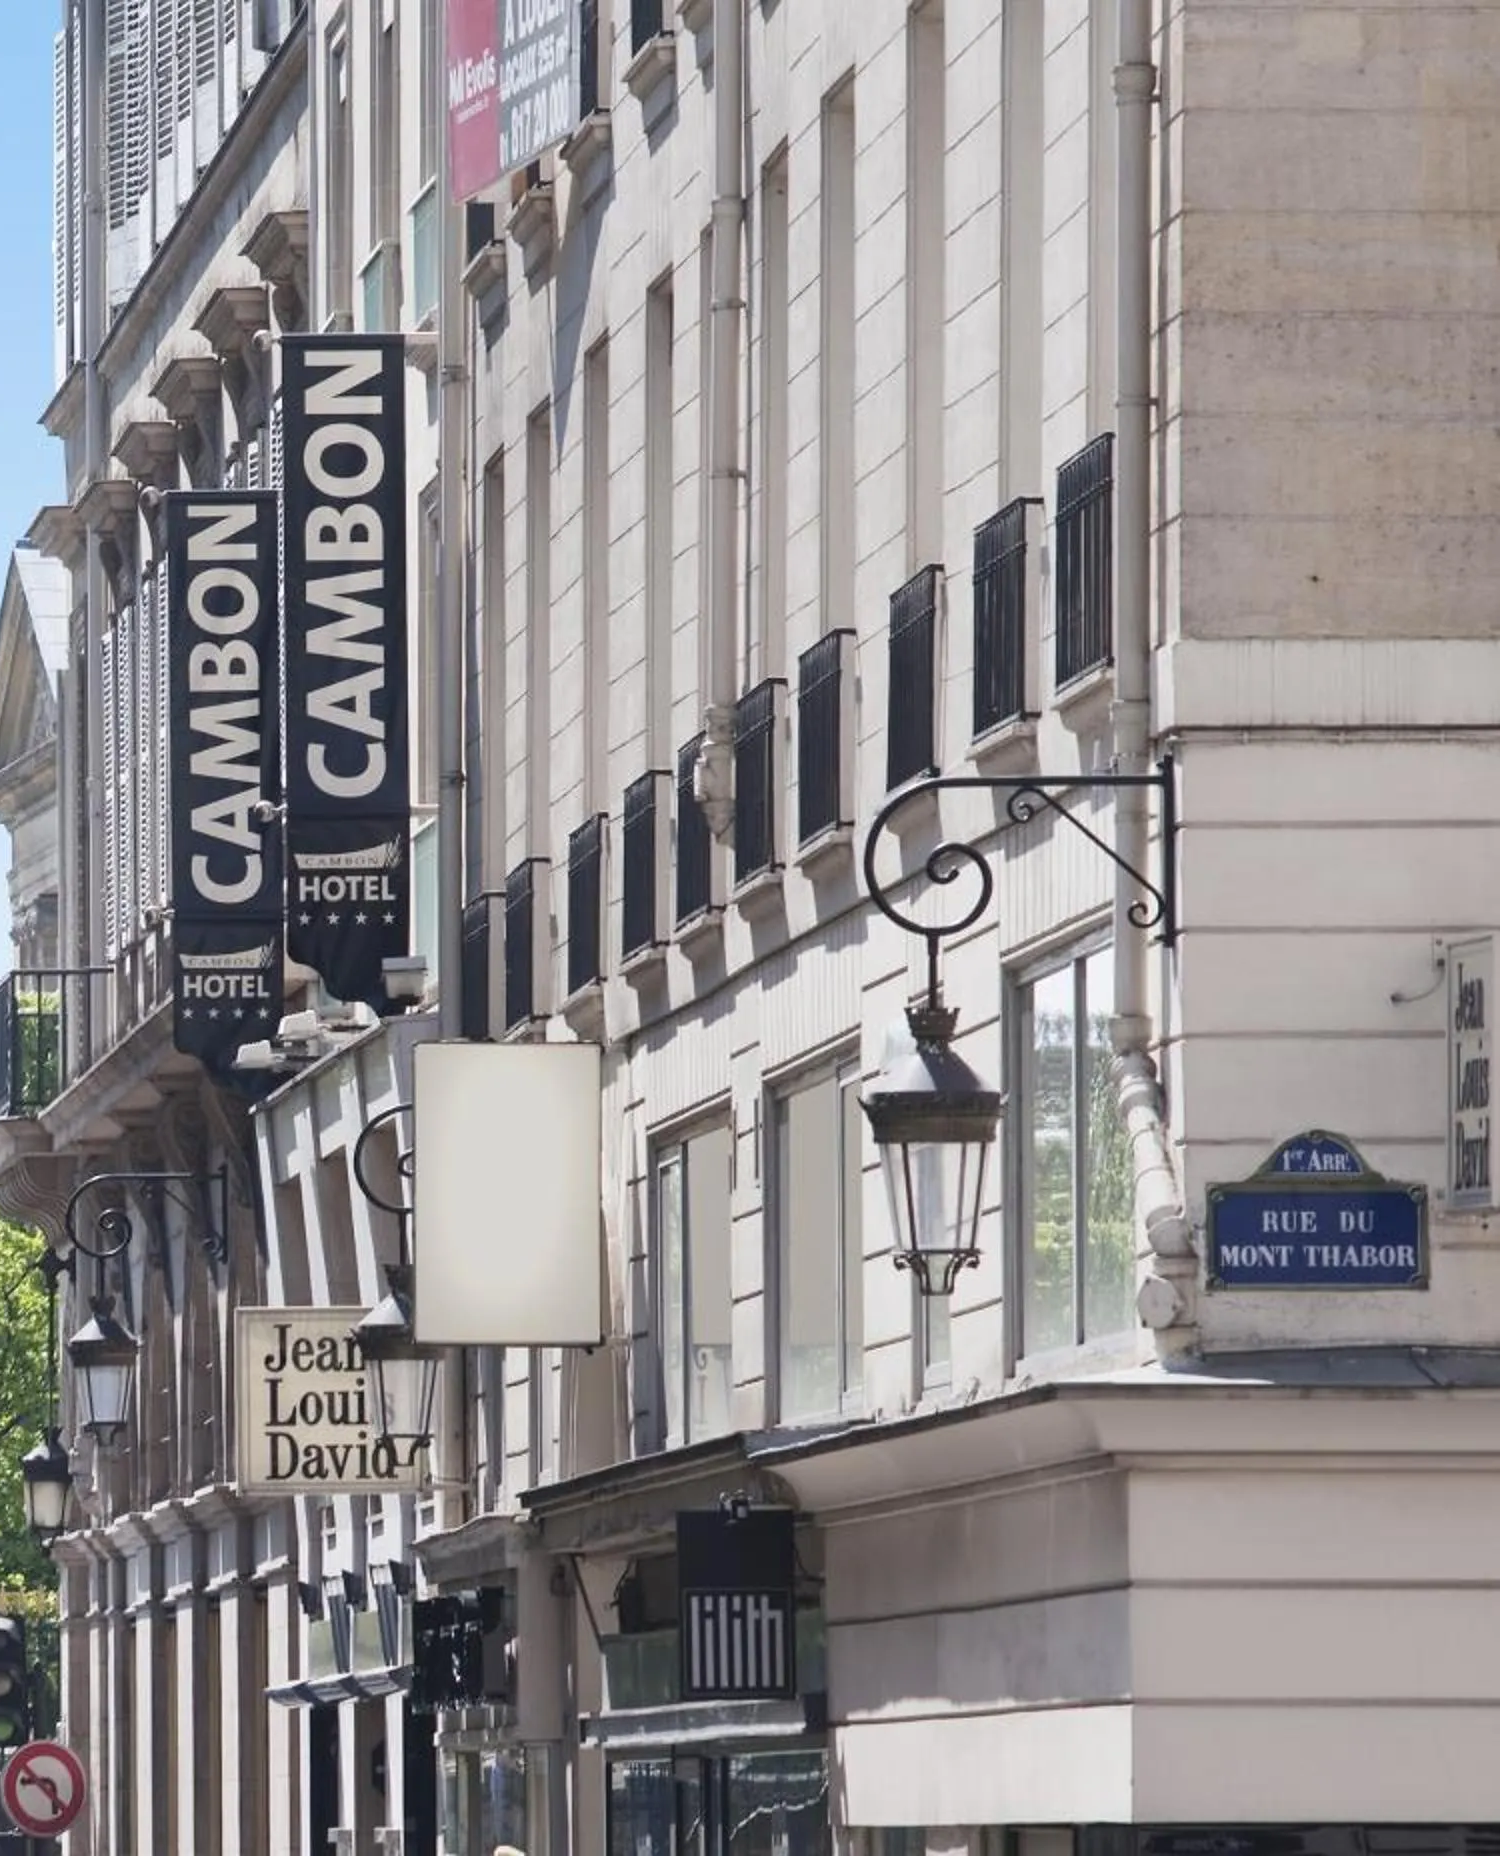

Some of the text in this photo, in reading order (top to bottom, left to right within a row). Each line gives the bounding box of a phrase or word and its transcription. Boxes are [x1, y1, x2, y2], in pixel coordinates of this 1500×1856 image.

[518, 0, 565, 38] LOU
[303, 349, 387, 798] CAMBON
[187, 504, 263, 904] CAMBON
[299, 875, 396, 901] HOTEL
[183, 974, 270, 999] HOTEL
[1262, 1211, 1375, 1233] RUE DU
[1220, 1245, 1416, 1267] MONT THABOR
[264, 1431, 399, 1481] David
[691, 1595, 785, 1688] lilith
